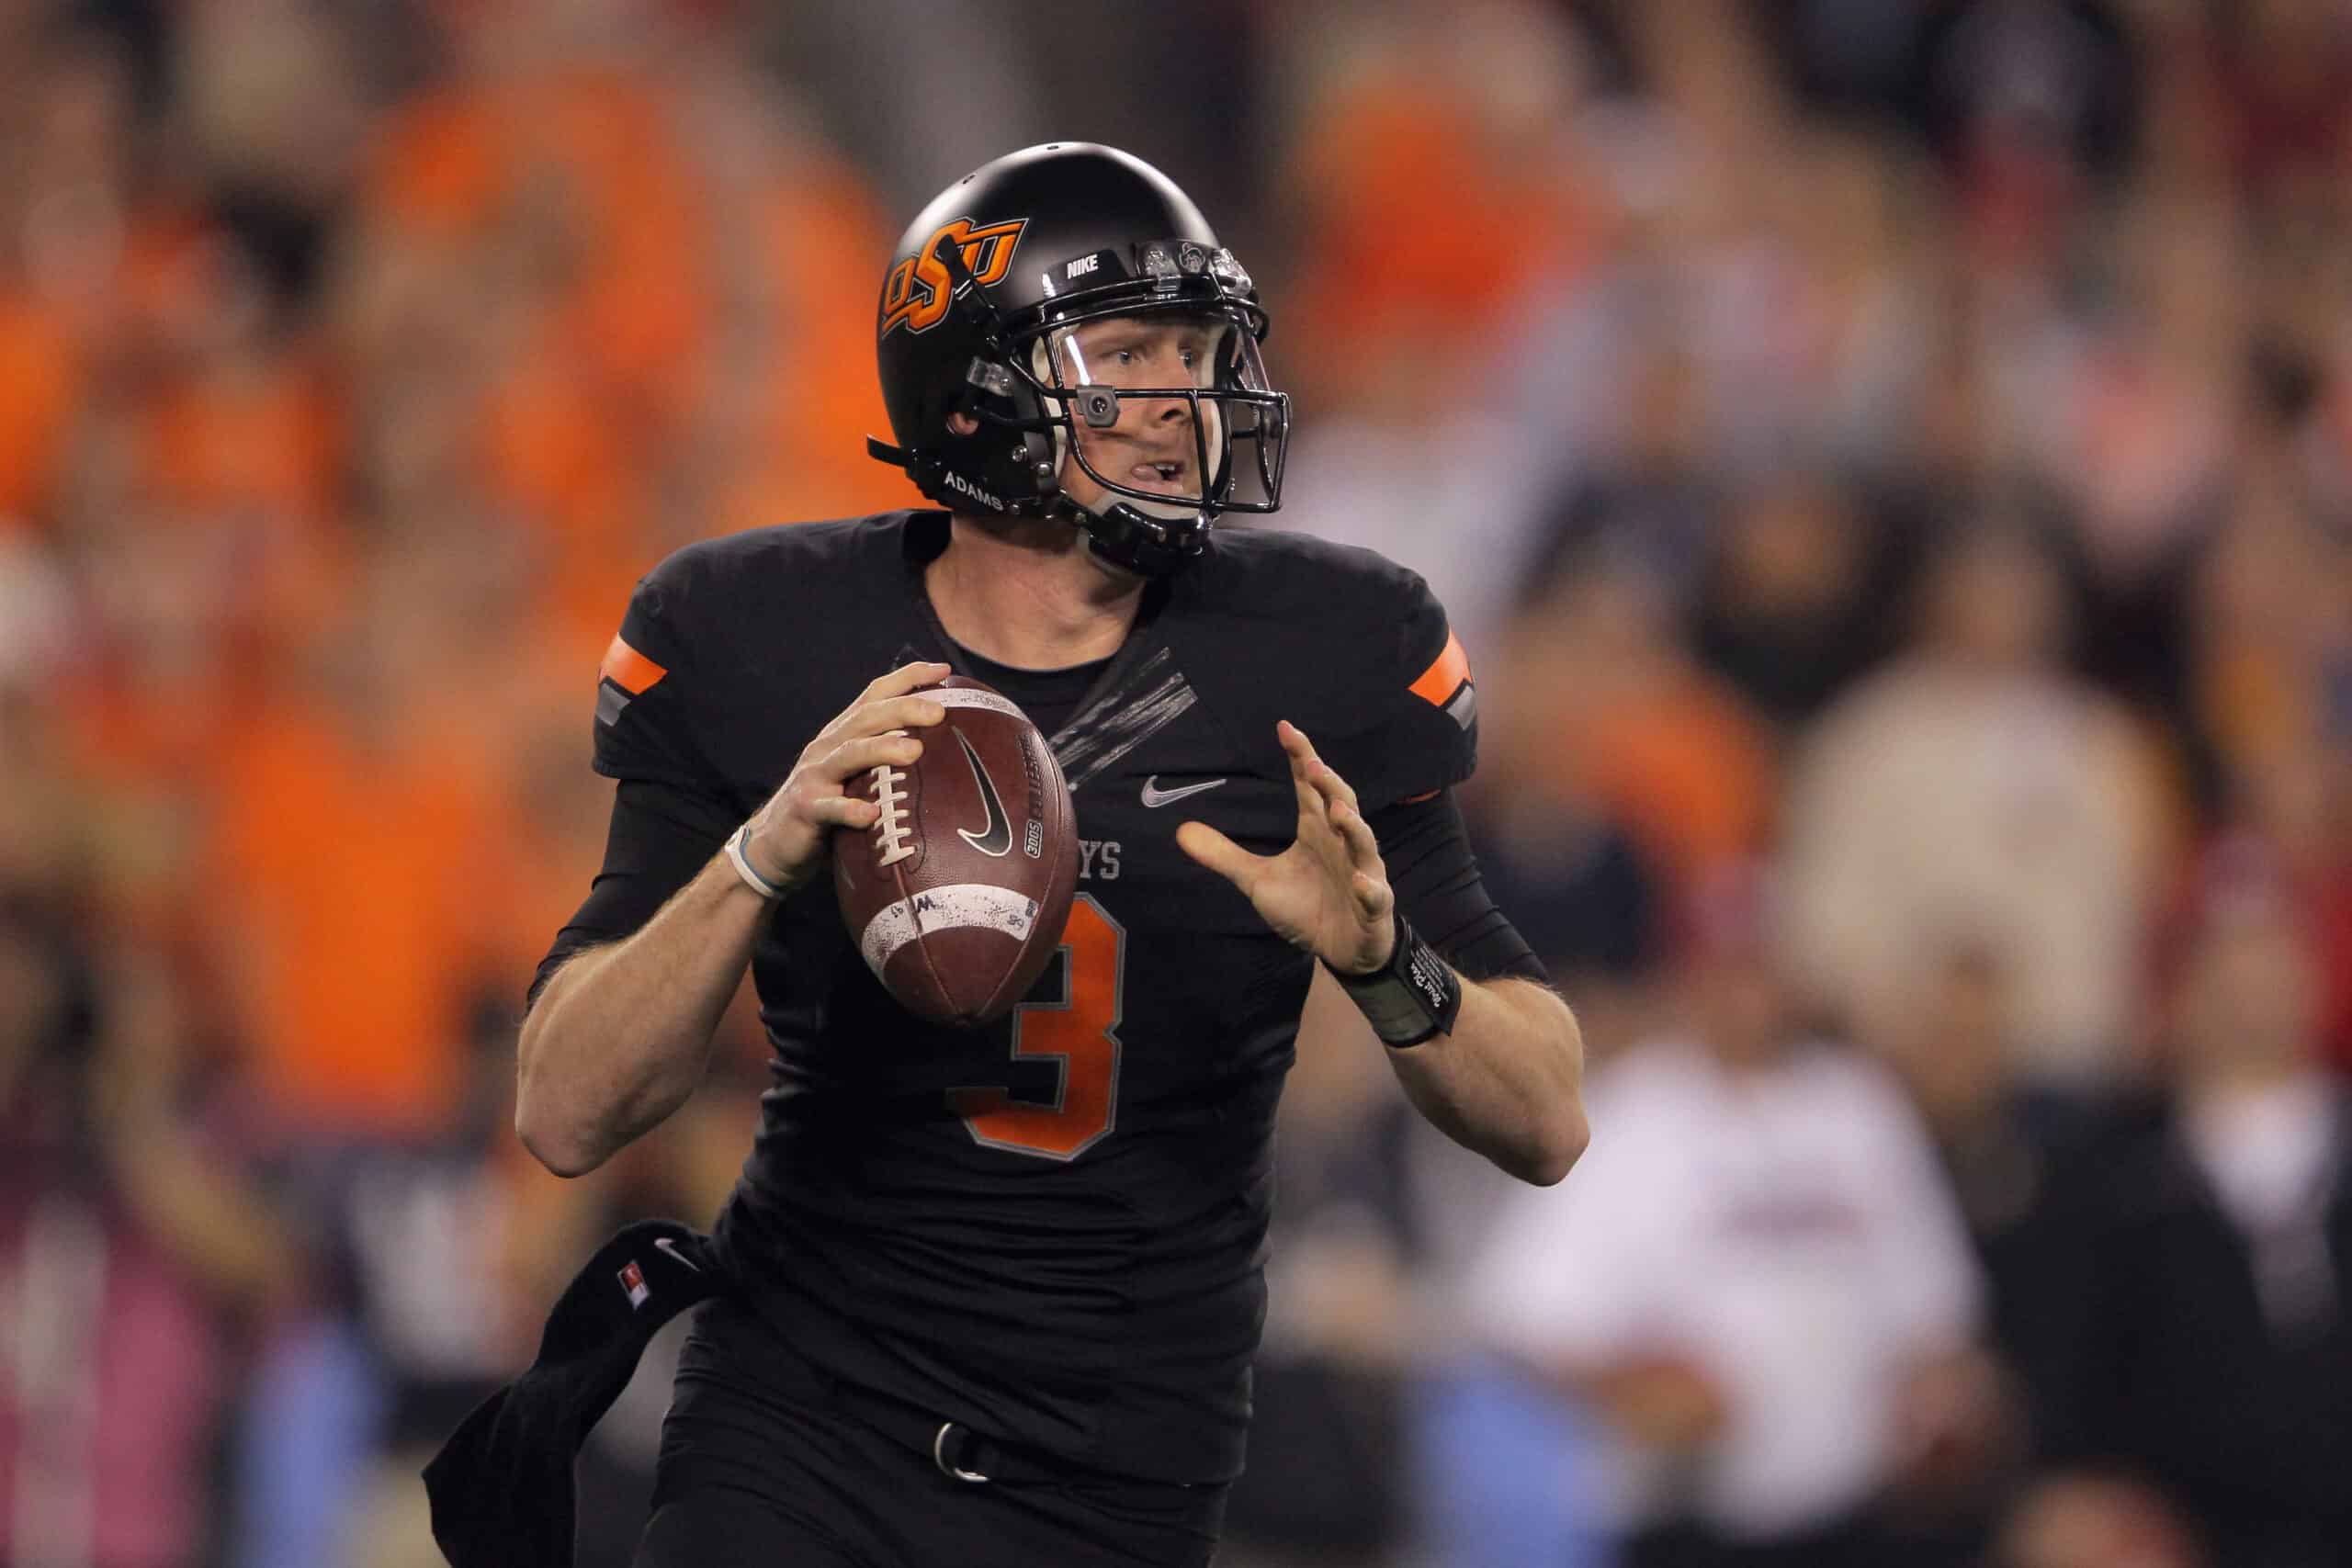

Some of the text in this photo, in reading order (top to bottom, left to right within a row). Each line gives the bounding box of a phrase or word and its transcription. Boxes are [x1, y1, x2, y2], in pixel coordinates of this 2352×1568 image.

[881, 216, 1030, 336] OSU
[1067, 254, 1099, 279] NIKE
[944, 469, 1004, 512] ADAMS
[1025, 820, 1042, 855] 3005
[944, 891, 1126, 1162] 3
